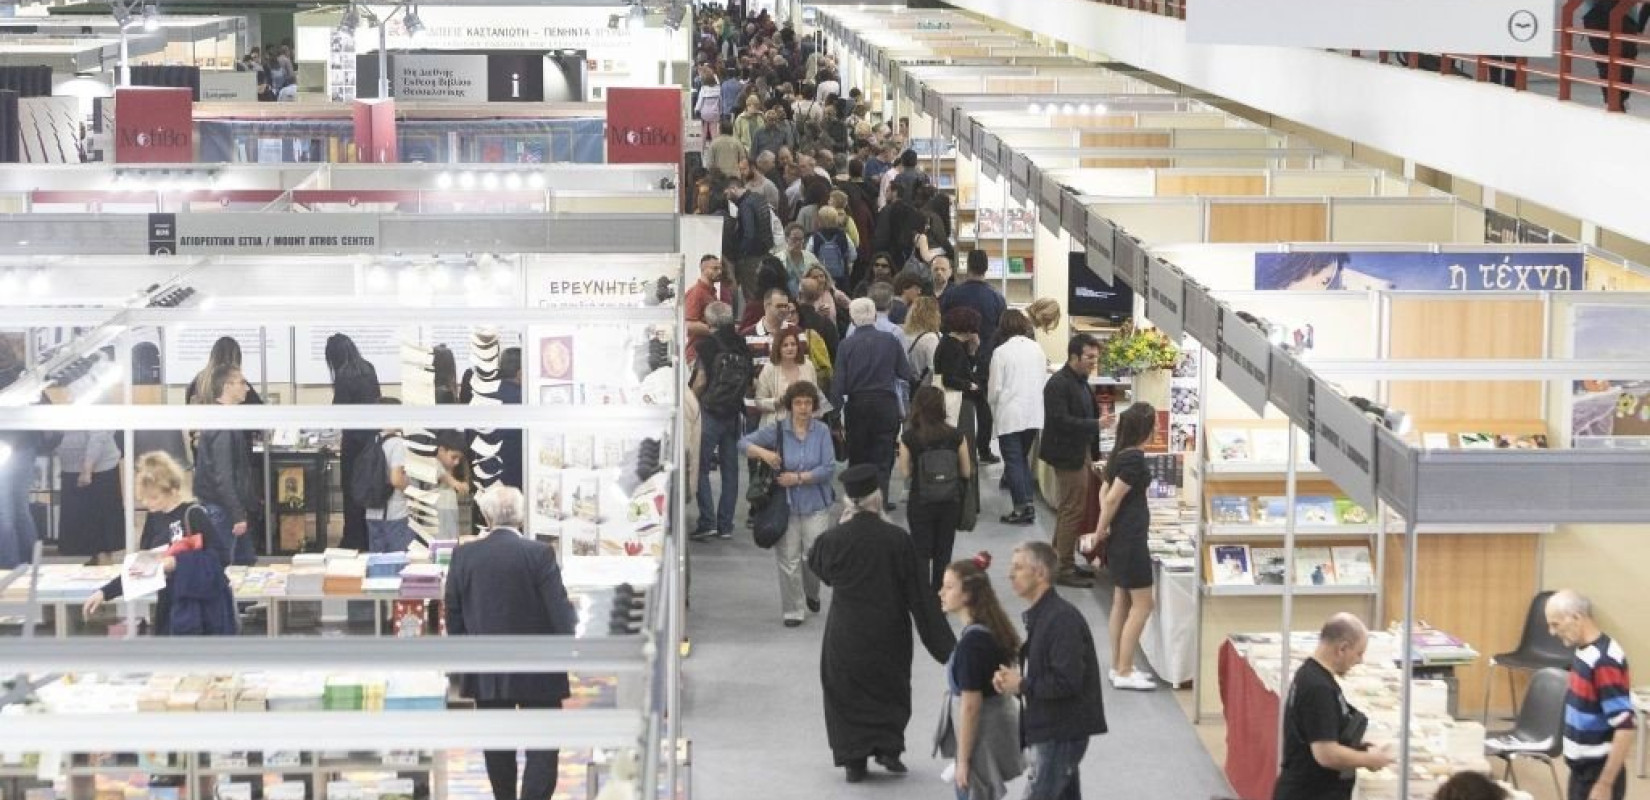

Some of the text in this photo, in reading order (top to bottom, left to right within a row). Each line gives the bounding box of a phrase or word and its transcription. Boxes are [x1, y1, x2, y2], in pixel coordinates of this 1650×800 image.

[544, 27, 590, 37] ΠΕΝΗΝΤΑ
[180, 236, 235, 246] ΑΓΙΟΡΕΙΤΙΚΗ
[238, 236, 262, 246] ΕΣΤΙΑ
[273, 236, 306, 246] MOUNT
[308, 236, 338, 246] ATHOS
[341, 236, 375, 246] CENTER
[1448, 255, 1572, 291] η τέχνη
